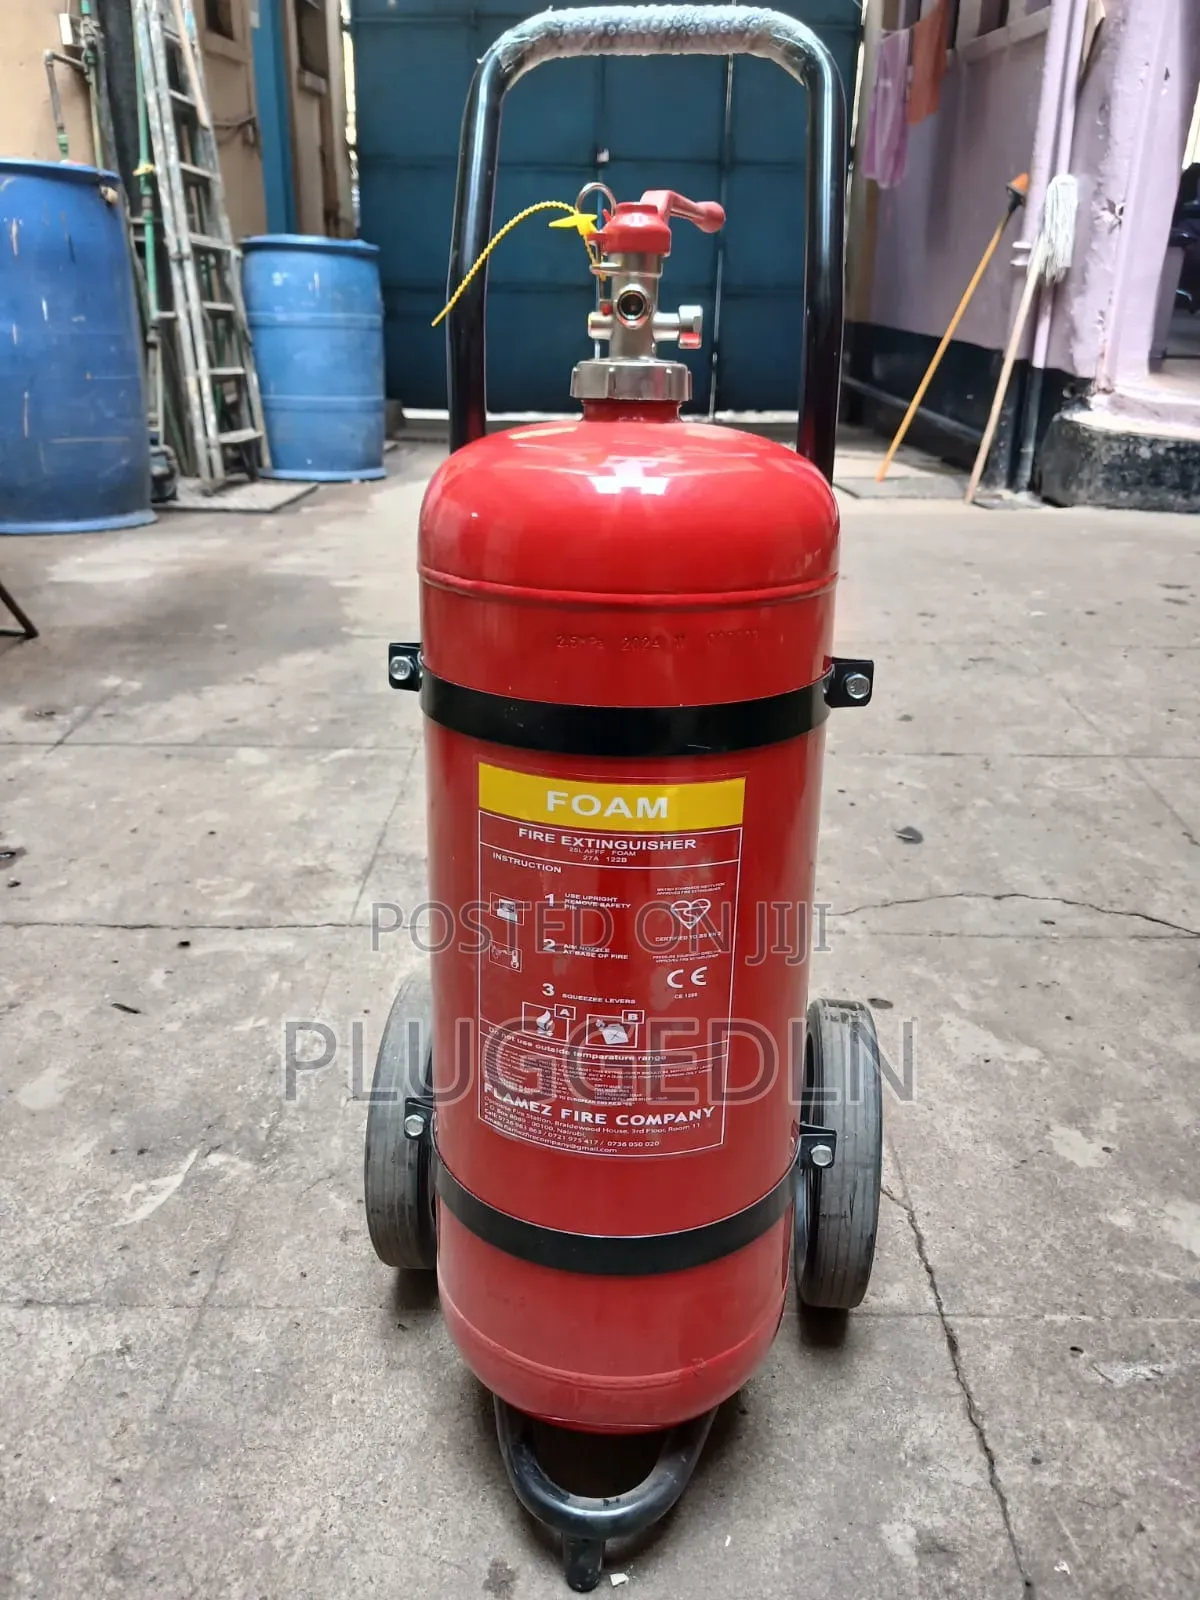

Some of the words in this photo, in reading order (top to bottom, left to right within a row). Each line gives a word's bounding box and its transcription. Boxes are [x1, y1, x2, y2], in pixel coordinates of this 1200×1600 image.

[546, 790, 669, 819] FOAM
[518, 828, 556, 844] FIRE
[561, 835, 697, 850] EXTINGUISHER
[492, 852, 562, 873] INSTRUCTION
[544, 893, 555, 907] 1
[564, 899, 598, 907] REMOVE
[542, 938, 556, 952] 2
[579, 945, 611, 953] NOZZLE
[574, 950, 597, 958] BASE
[541, 982, 556, 996] 3
[559, 1008, 570, 1016] A
[627, 1013, 638, 1021] B
[488, 1026, 499, 1035] Do
[501, 1032, 516, 1042] not
[517, 1038, 533, 1047] use
[535, 1043, 571, 1056] outside
[638, 1055, 667, 1063] range
[484, 1082, 553, 1116] FLAMEZ
[560, 1108, 607, 1125] FIRE
[615, 1105, 716, 1126] COMPANY
[554, 1119, 601, 1133] Braidewood
[692, 1122, 701, 1130] 11
[547, 1131, 567, 1141] 0721
[583, 1137, 599, 1145] 417
